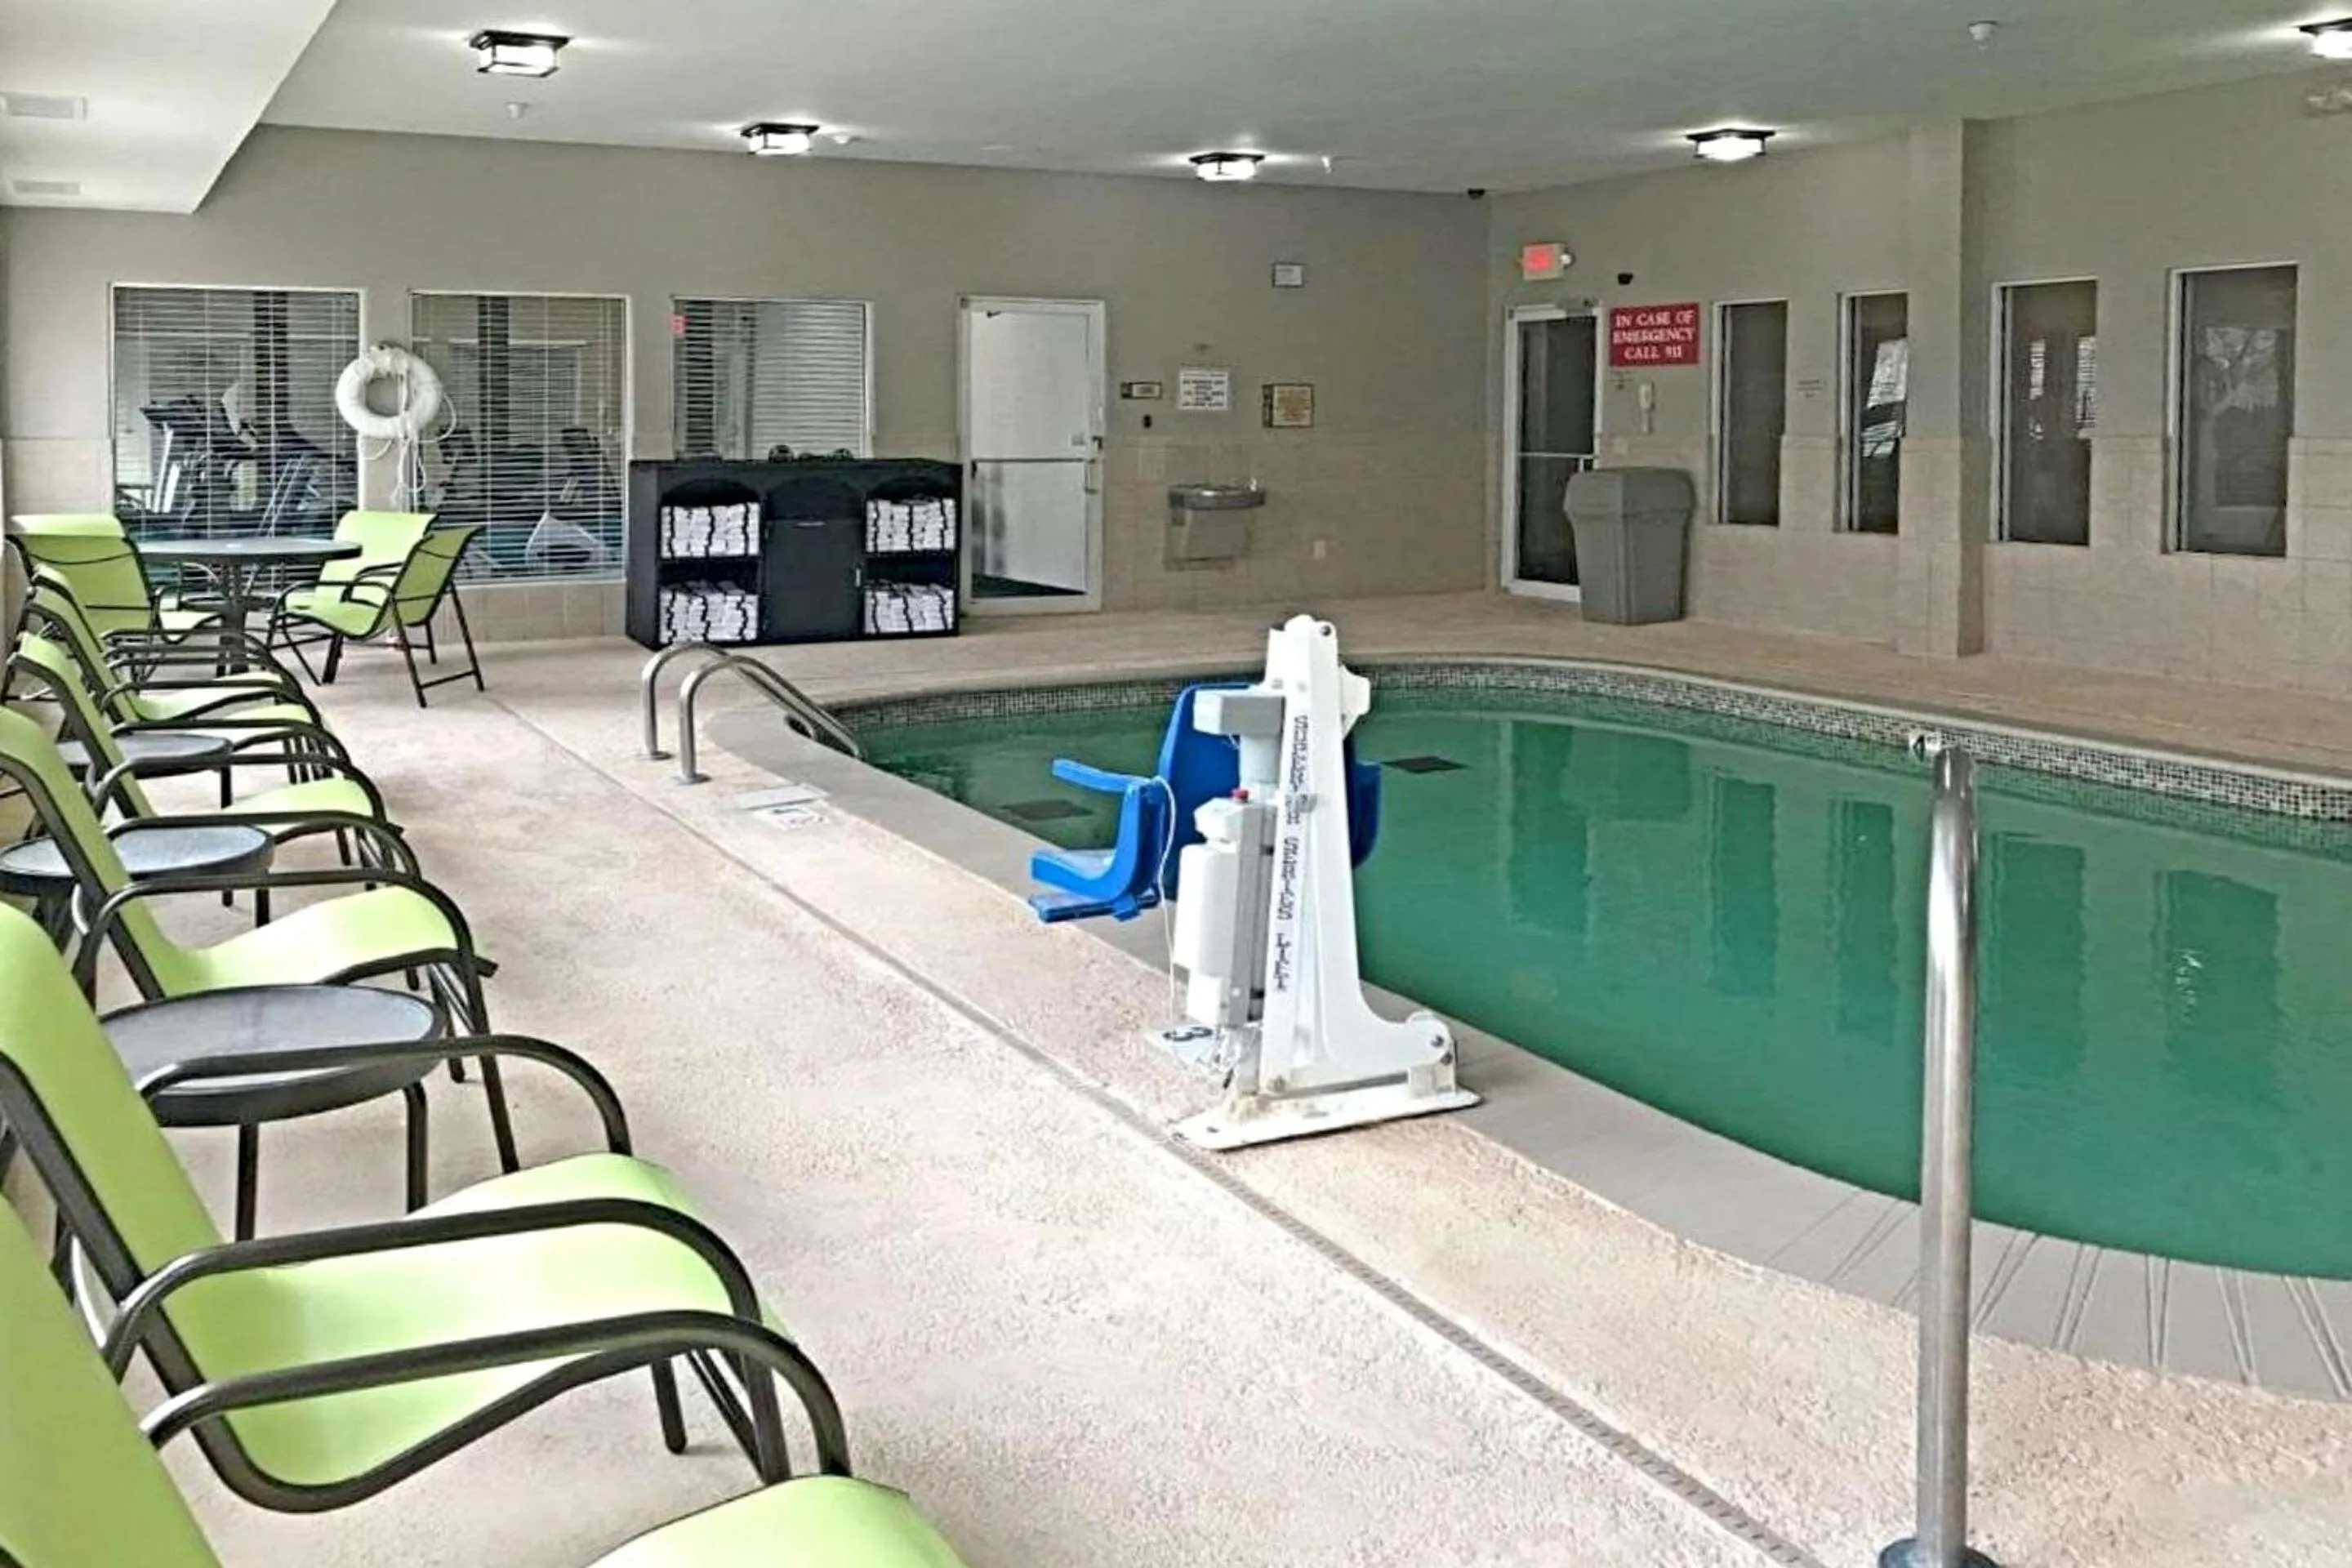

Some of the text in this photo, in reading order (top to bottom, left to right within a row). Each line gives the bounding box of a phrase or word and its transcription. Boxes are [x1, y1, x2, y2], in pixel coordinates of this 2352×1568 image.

[1615, 310, 1695, 327] IN CASE OF
[1613, 327, 1696, 344] EMERGENCY
[1624, 345, 1660, 359] CALL
